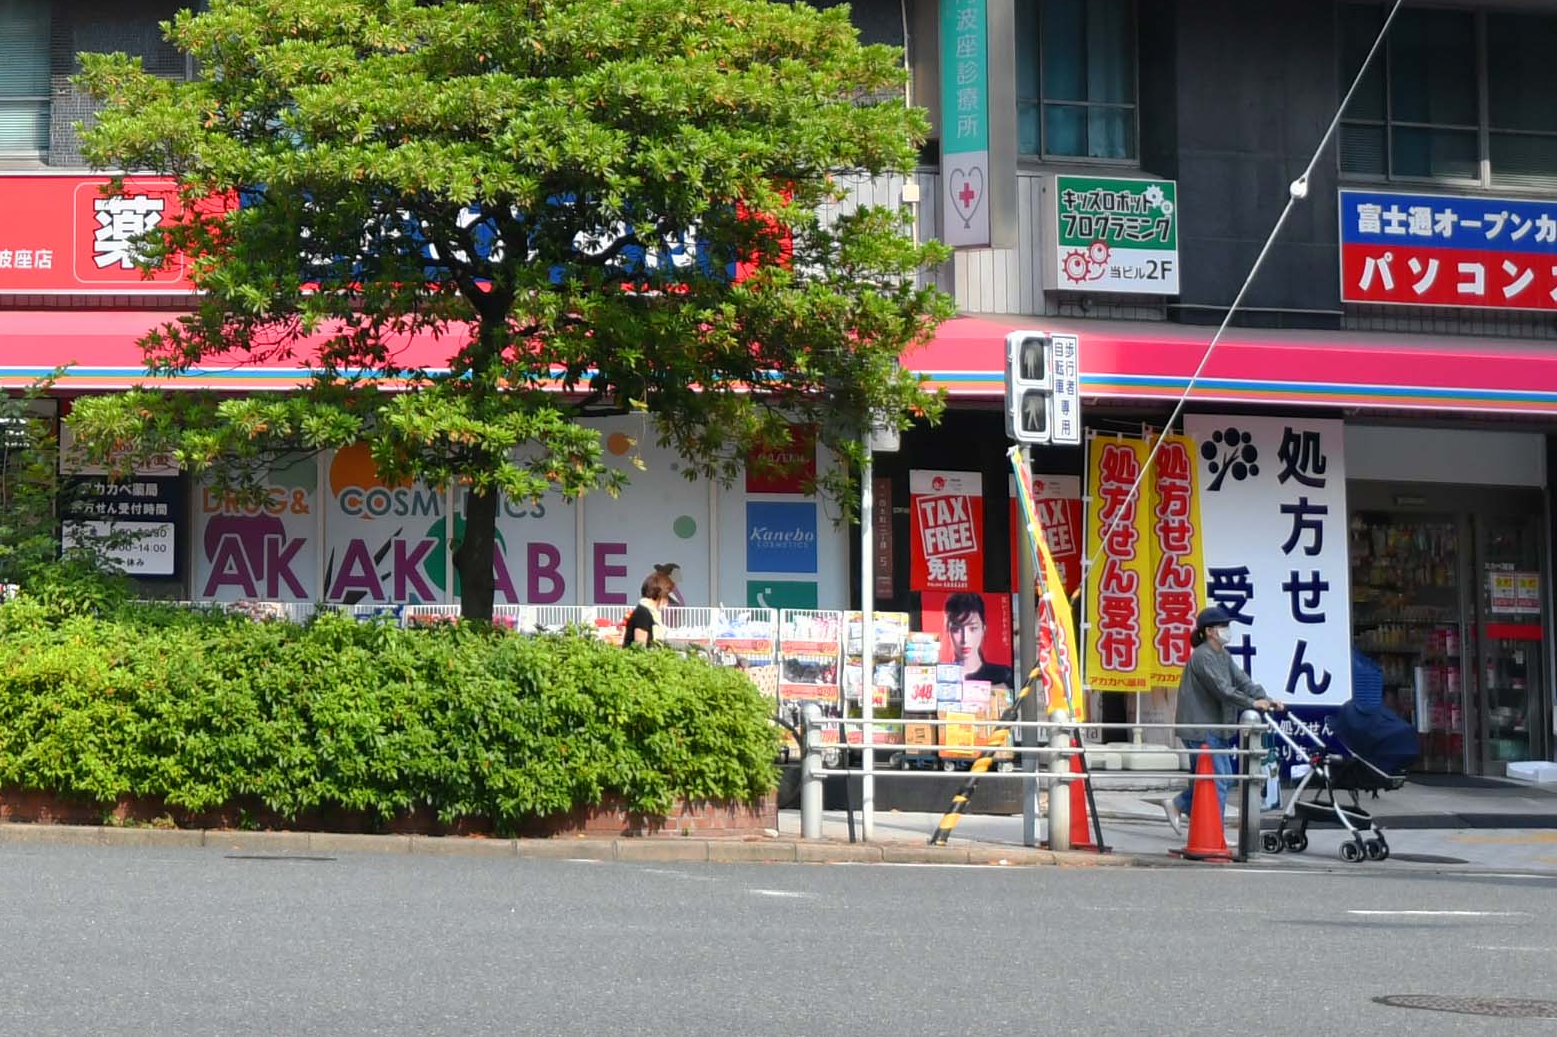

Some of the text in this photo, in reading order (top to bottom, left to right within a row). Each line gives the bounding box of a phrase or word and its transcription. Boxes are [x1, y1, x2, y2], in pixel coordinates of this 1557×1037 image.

[1061, 188, 1154, 214] キッズロボット
[91, 193, 165, 270] 薬
[1060, 212, 1172, 242] プログラミング
[1356, 203, 1557, 243] 富士通オープンカ
[1358, 251, 1557, 302] パソコン
[1054, 341, 1065, 394] 自転車
[1064, 341, 1075, 396] 歩行者
[1060, 399, 1071, 436] 専用
[921, 496, 968, 527] TAX
[1038, 499, 1069, 526] AX
[749, 525, 814, 542] Kanebo
[924, 522, 973, 554] FREE
[1045, 528, 1073, 554] EE
[926, 558, 968, 581] 免税
[1098, 445, 1140, 671] 処方せん受付
[1155, 443, 1195, 666] 処方せん受付
[1277, 426, 1332, 696] 処方せん
[911, 683, 934, 700] 348
